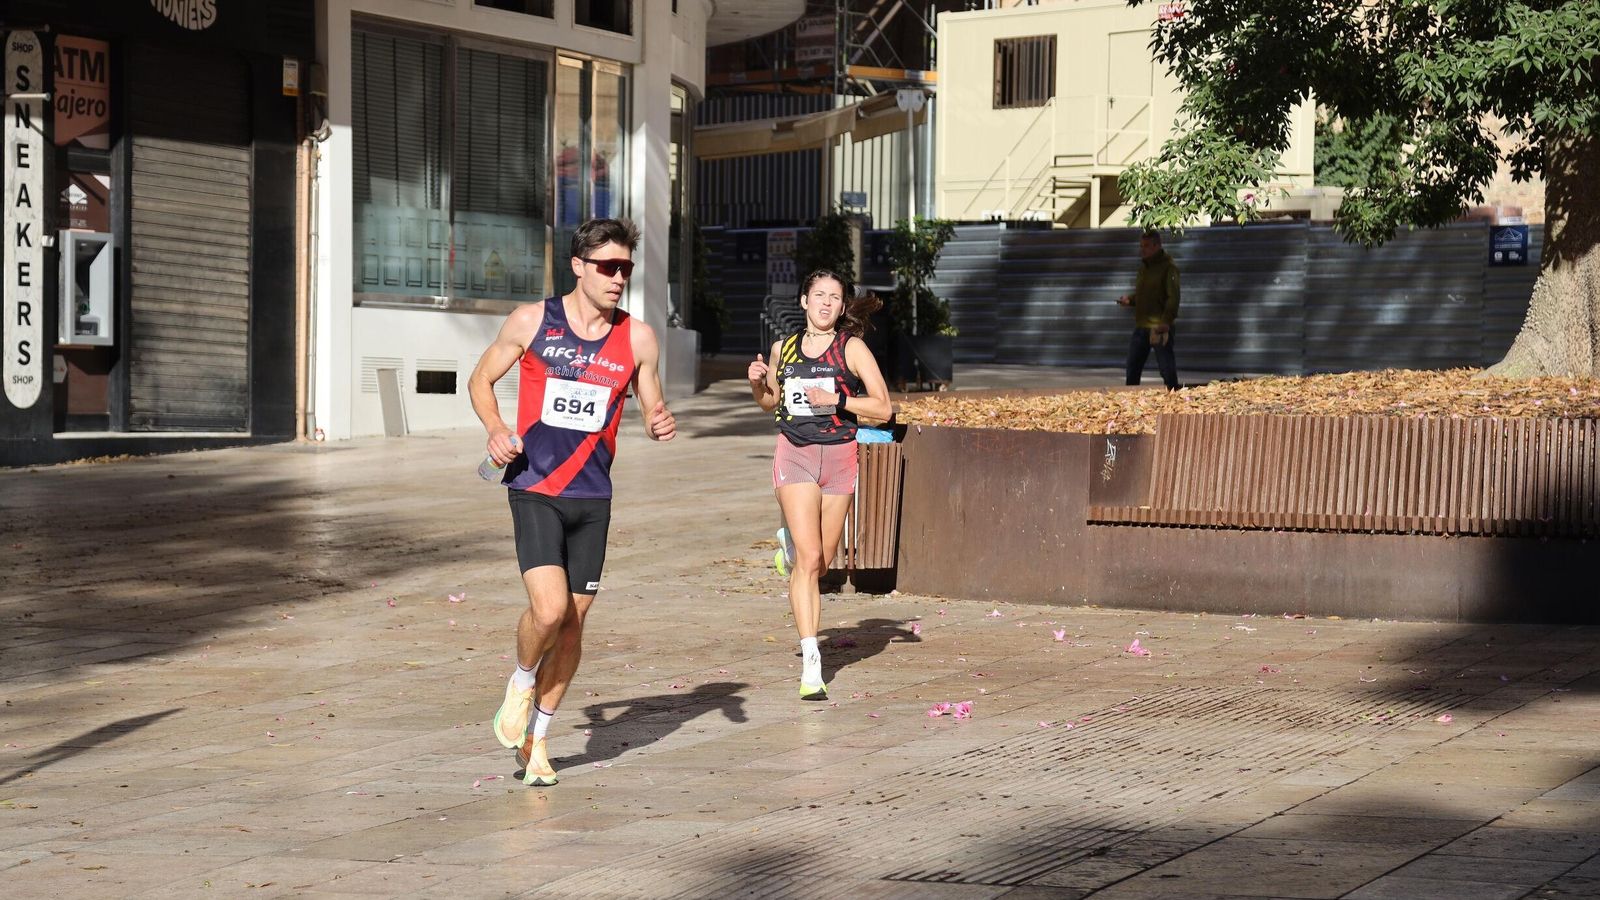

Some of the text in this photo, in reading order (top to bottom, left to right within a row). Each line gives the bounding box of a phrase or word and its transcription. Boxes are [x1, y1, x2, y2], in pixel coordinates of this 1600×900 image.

[12, 42, 33, 53] SHOP
[53, 45, 105, 83] ATM
[54, 87, 107, 119] ajero
[16, 65, 32, 365] SNEAKERS
[542, 346, 625, 372] RFC Liège
[12, 375, 34, 385] SHOP
[553, 397, 595, 416] 694
